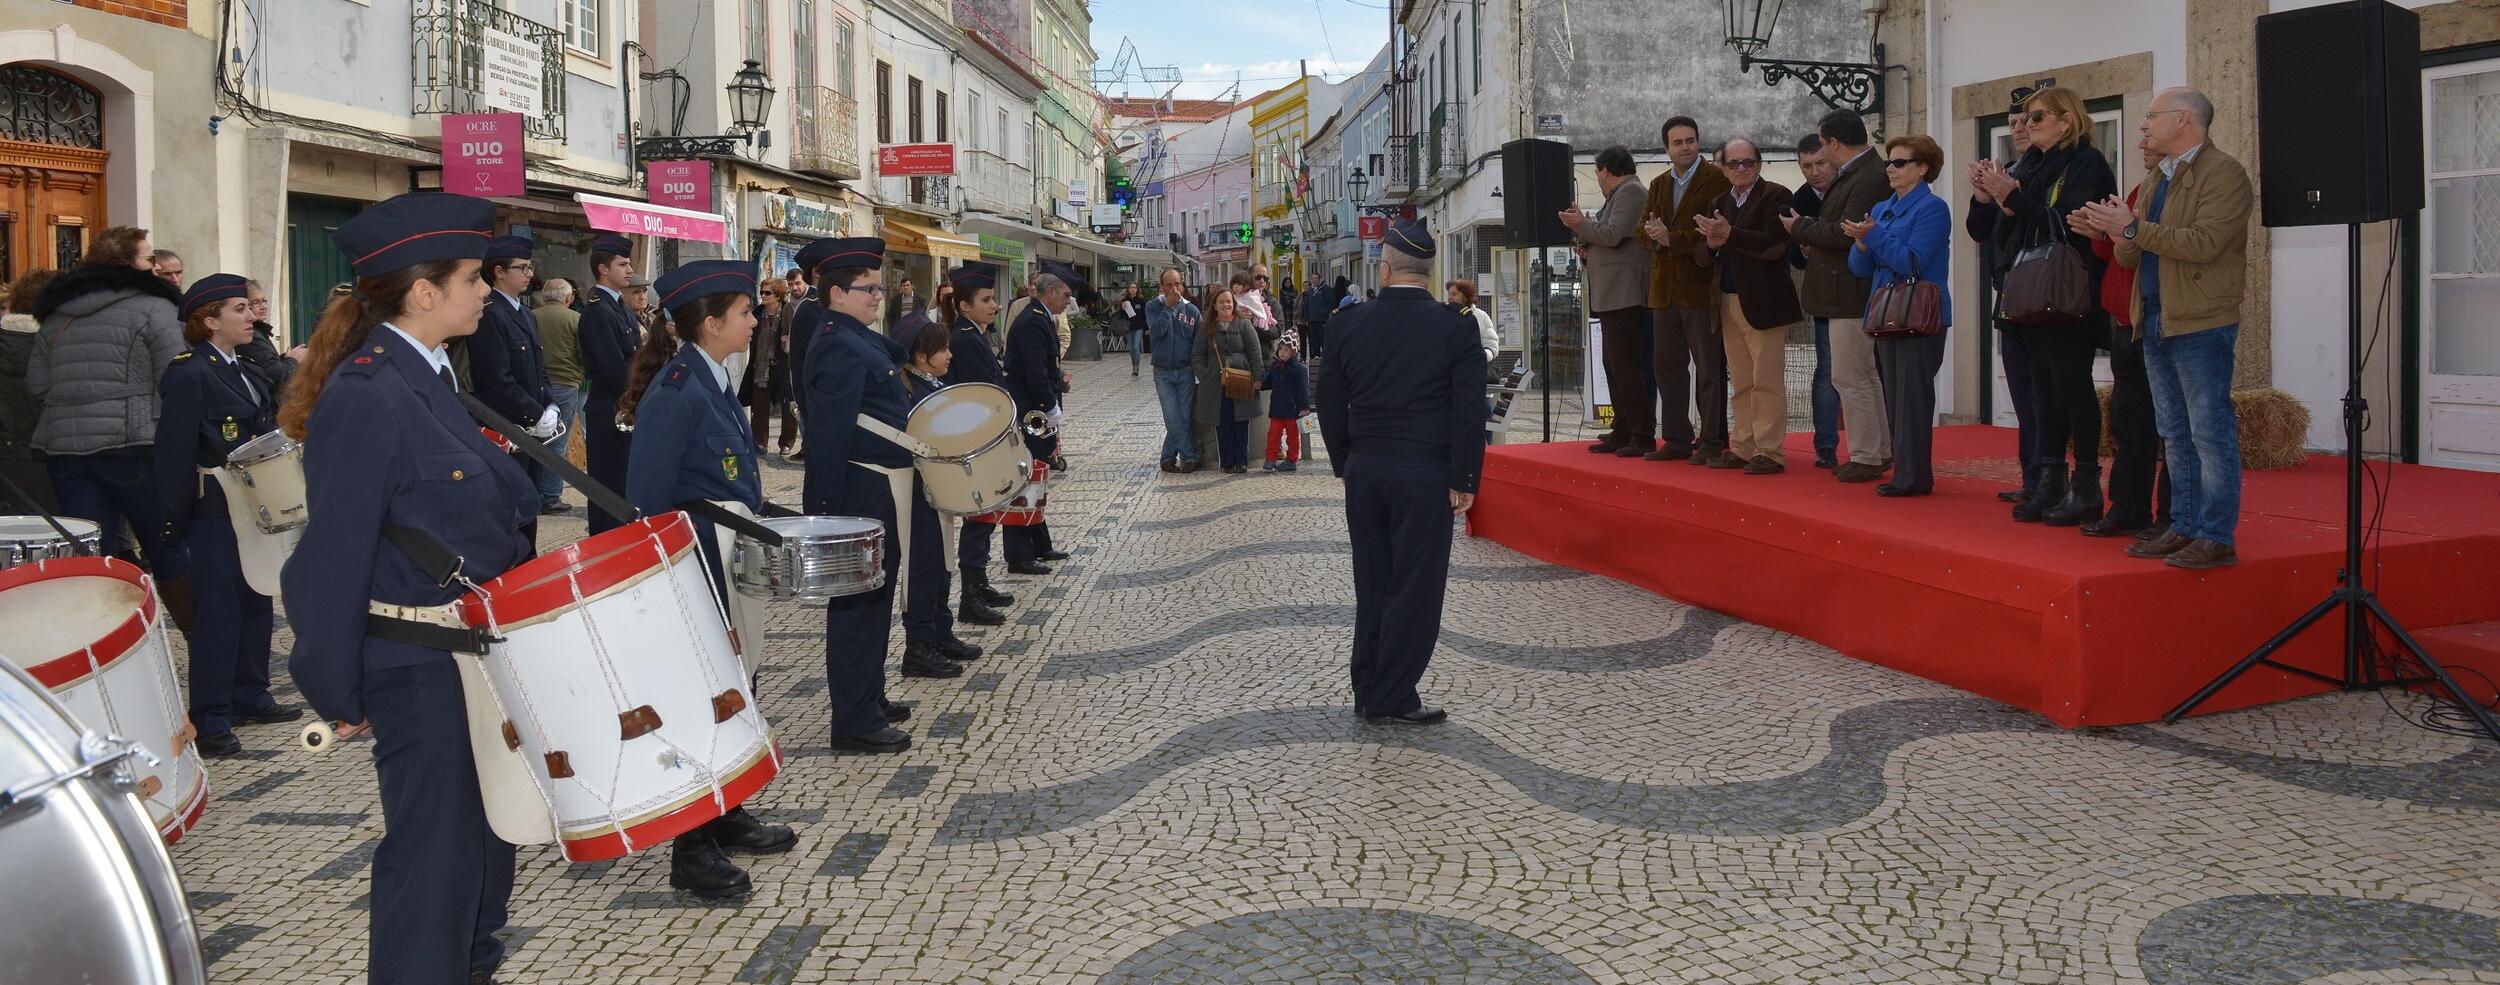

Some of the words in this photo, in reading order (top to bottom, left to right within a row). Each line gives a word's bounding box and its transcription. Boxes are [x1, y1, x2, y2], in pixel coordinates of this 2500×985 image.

[466, 121, 497, 131] OCRE
[462, 142, 503, 157] DUO
[667, 167, 691, 175] OCRE
[663, 182, 696, 194] DUO
[622, 213, 640, 225] OCRE
[643, 215, 663, 233] DUO
[663, 227, 678, 235] STORE
[1598, 405, 1615, 417] VIS
